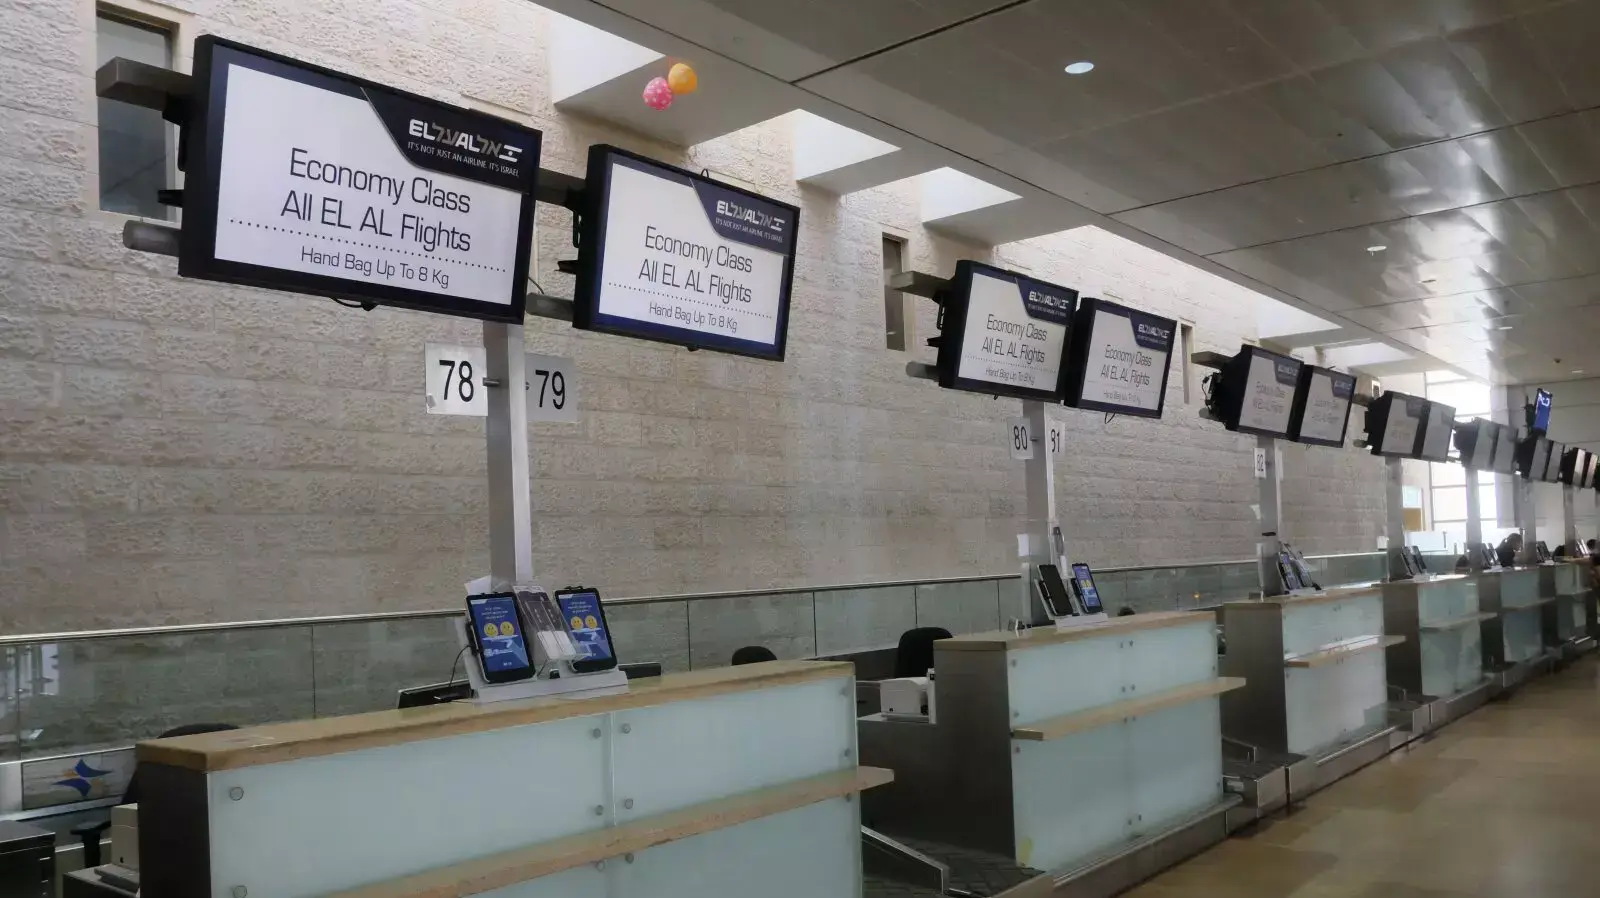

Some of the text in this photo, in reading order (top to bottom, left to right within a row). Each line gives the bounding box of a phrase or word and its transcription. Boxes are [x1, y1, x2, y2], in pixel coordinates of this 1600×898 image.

[408, 142, 419, 151] IT'S
[420, 145, 435, 155] NOT
[436, 149, 450, 158] JUST
[452, 153, 462, 162] AN
[489, 162, 500, 172] IT'S
[290, 148, 471, 213] Economy Class
[281, 190, 471, 252] All EL AL Flights
[301, 246, 449, 289] Hand Bag Up To 8 Kg
[644, 225, 753, 273] Economy Class
[638, 258, 752, 304] All EL AL Flights
[650, 302, 737, 333] Hand Bag Up To 8 Kg
[987, 314, 1047, 341] Economy Class
[982, 336, 1045, 364] All EL AL Flights
[439, 359, 474, 402] 78
[535, 370, 566, 410] 79
[1014, 425, 1028, 450] 80
